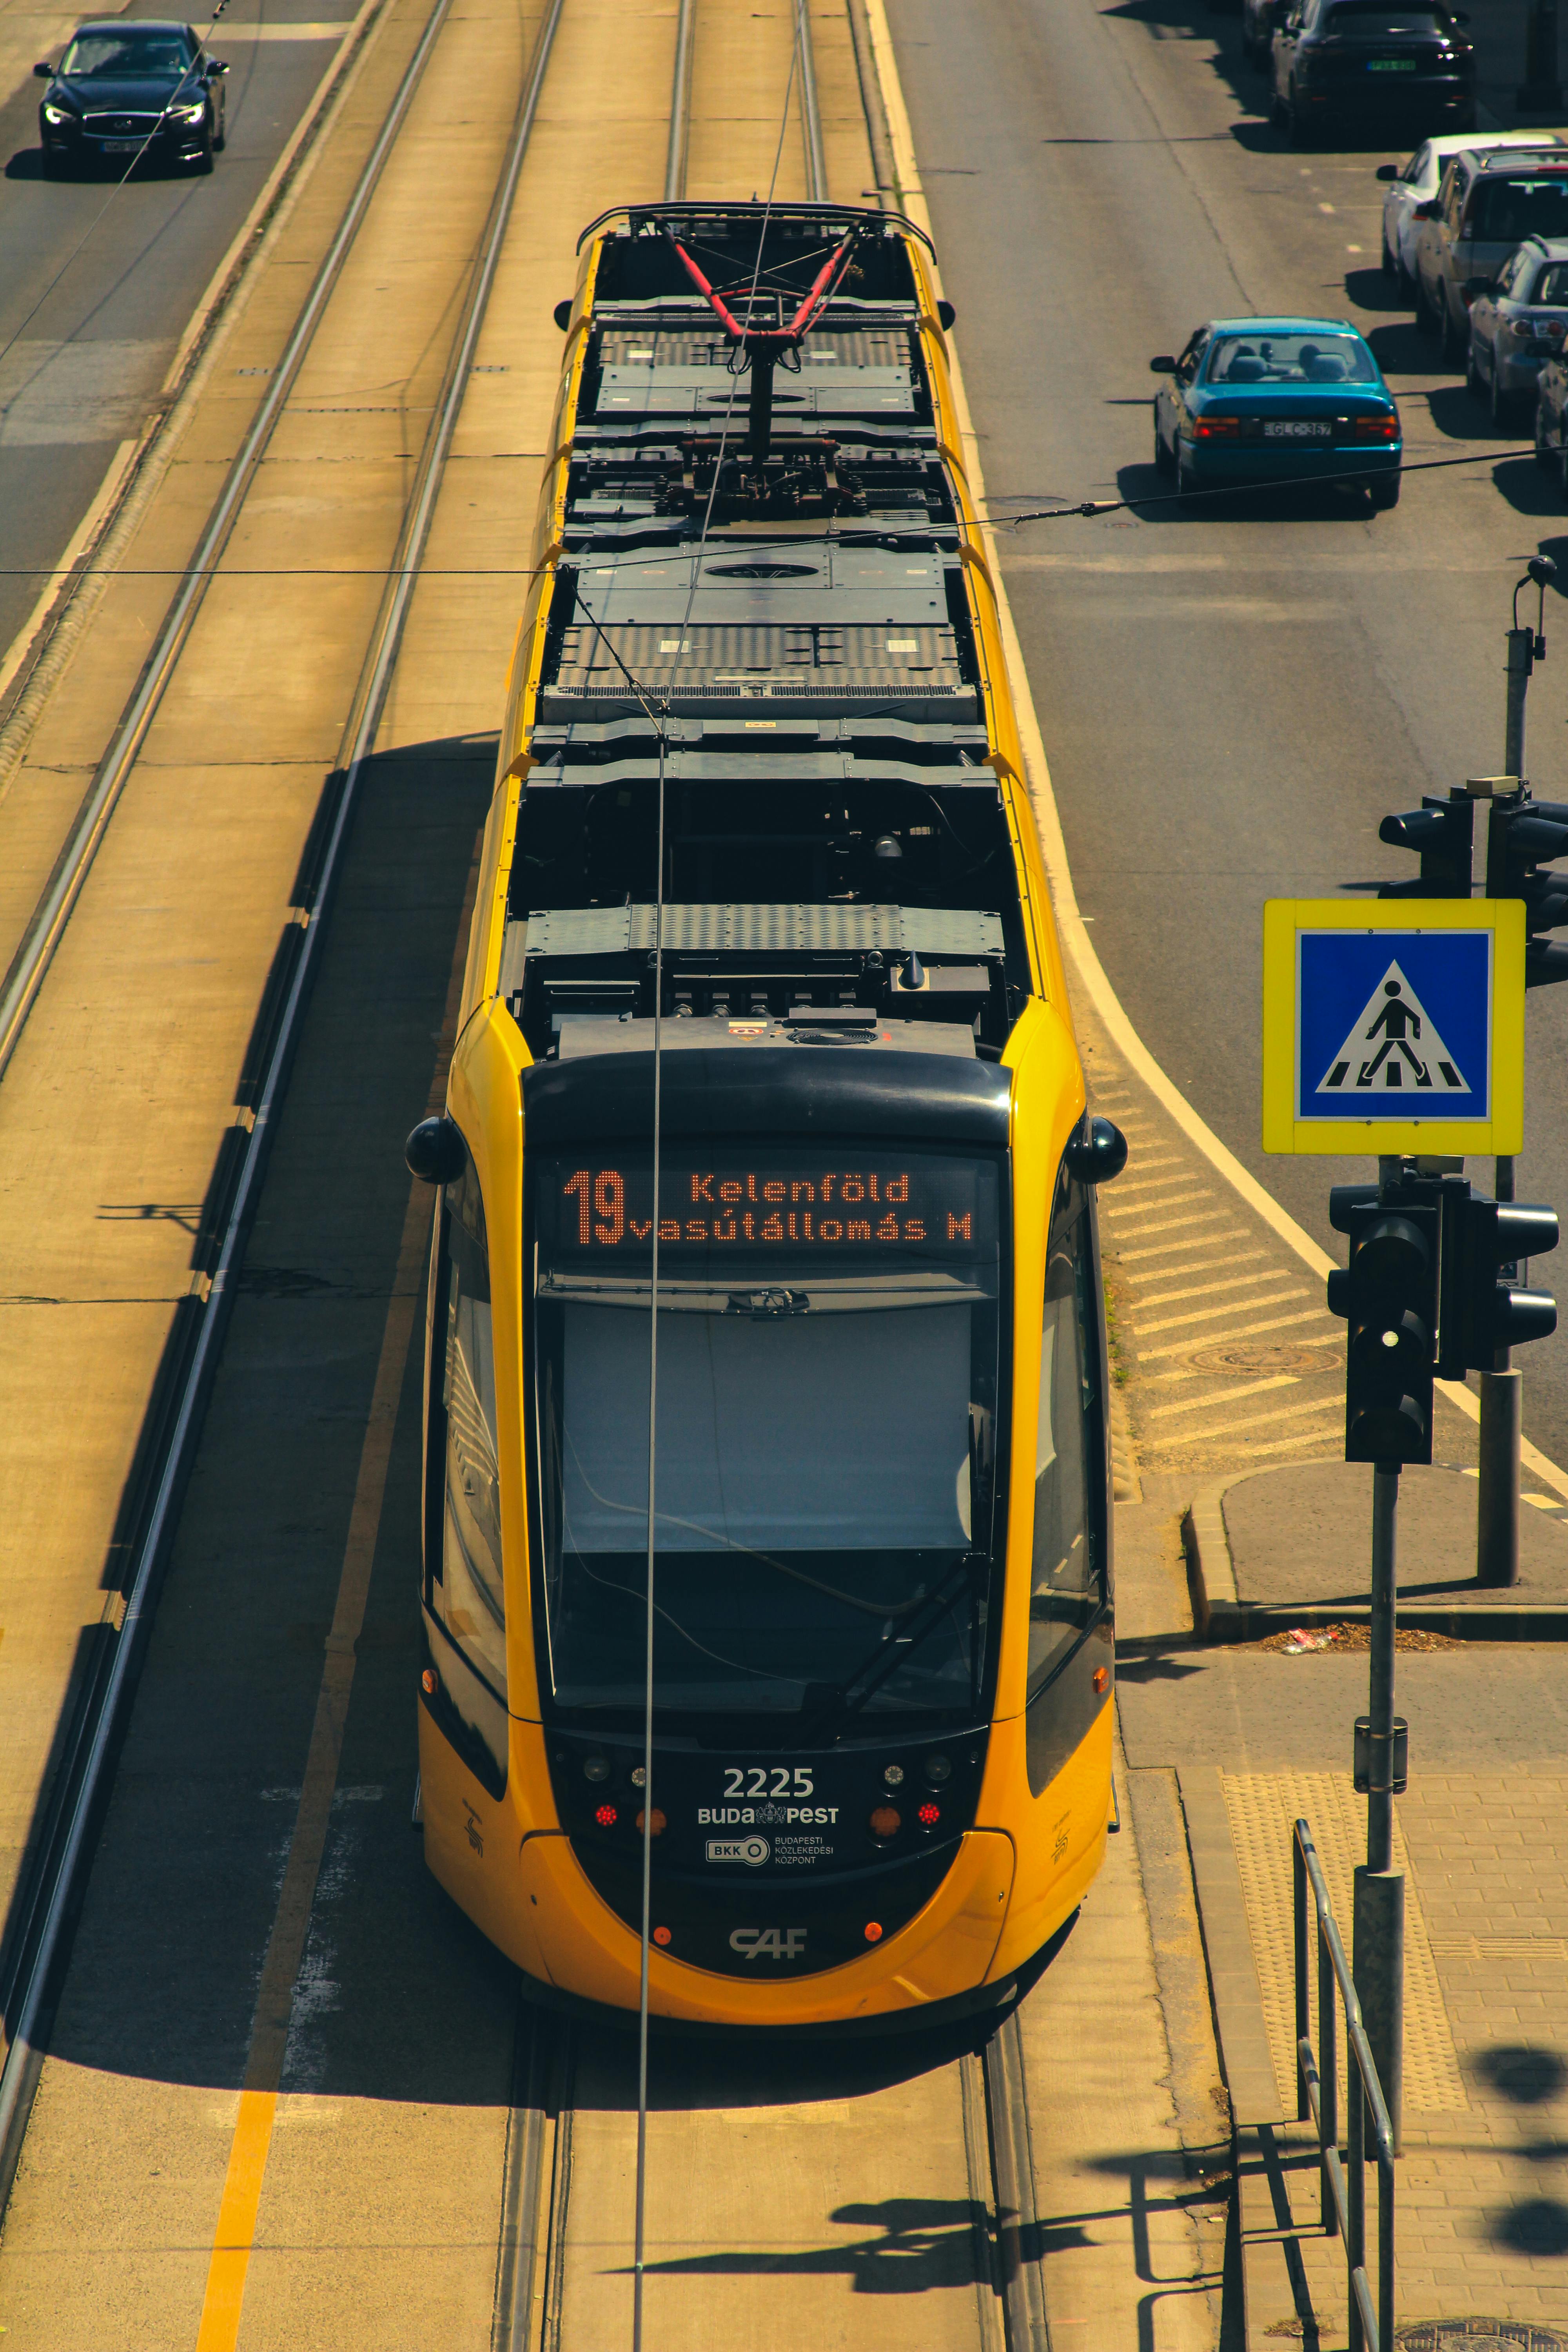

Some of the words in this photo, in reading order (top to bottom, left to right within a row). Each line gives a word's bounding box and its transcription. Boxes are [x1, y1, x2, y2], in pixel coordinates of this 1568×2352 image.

[691, 1174, 908, 1202] Kelenföld
[564, 1171, 624, 1244] 19
[630, 1209, 926, 1240] vasútállomás
[947, 1212, 971, 1240] M
[724, 1768, 813, 1797] 2225
[715, 1846, 741, 1856] BKK
[775, 1845, 833, 1854] KÖZLEKEDÉSI
[775, 1855, 816, 1864] KÖZPONT
[729, 1929, 807, 1959] CAF
